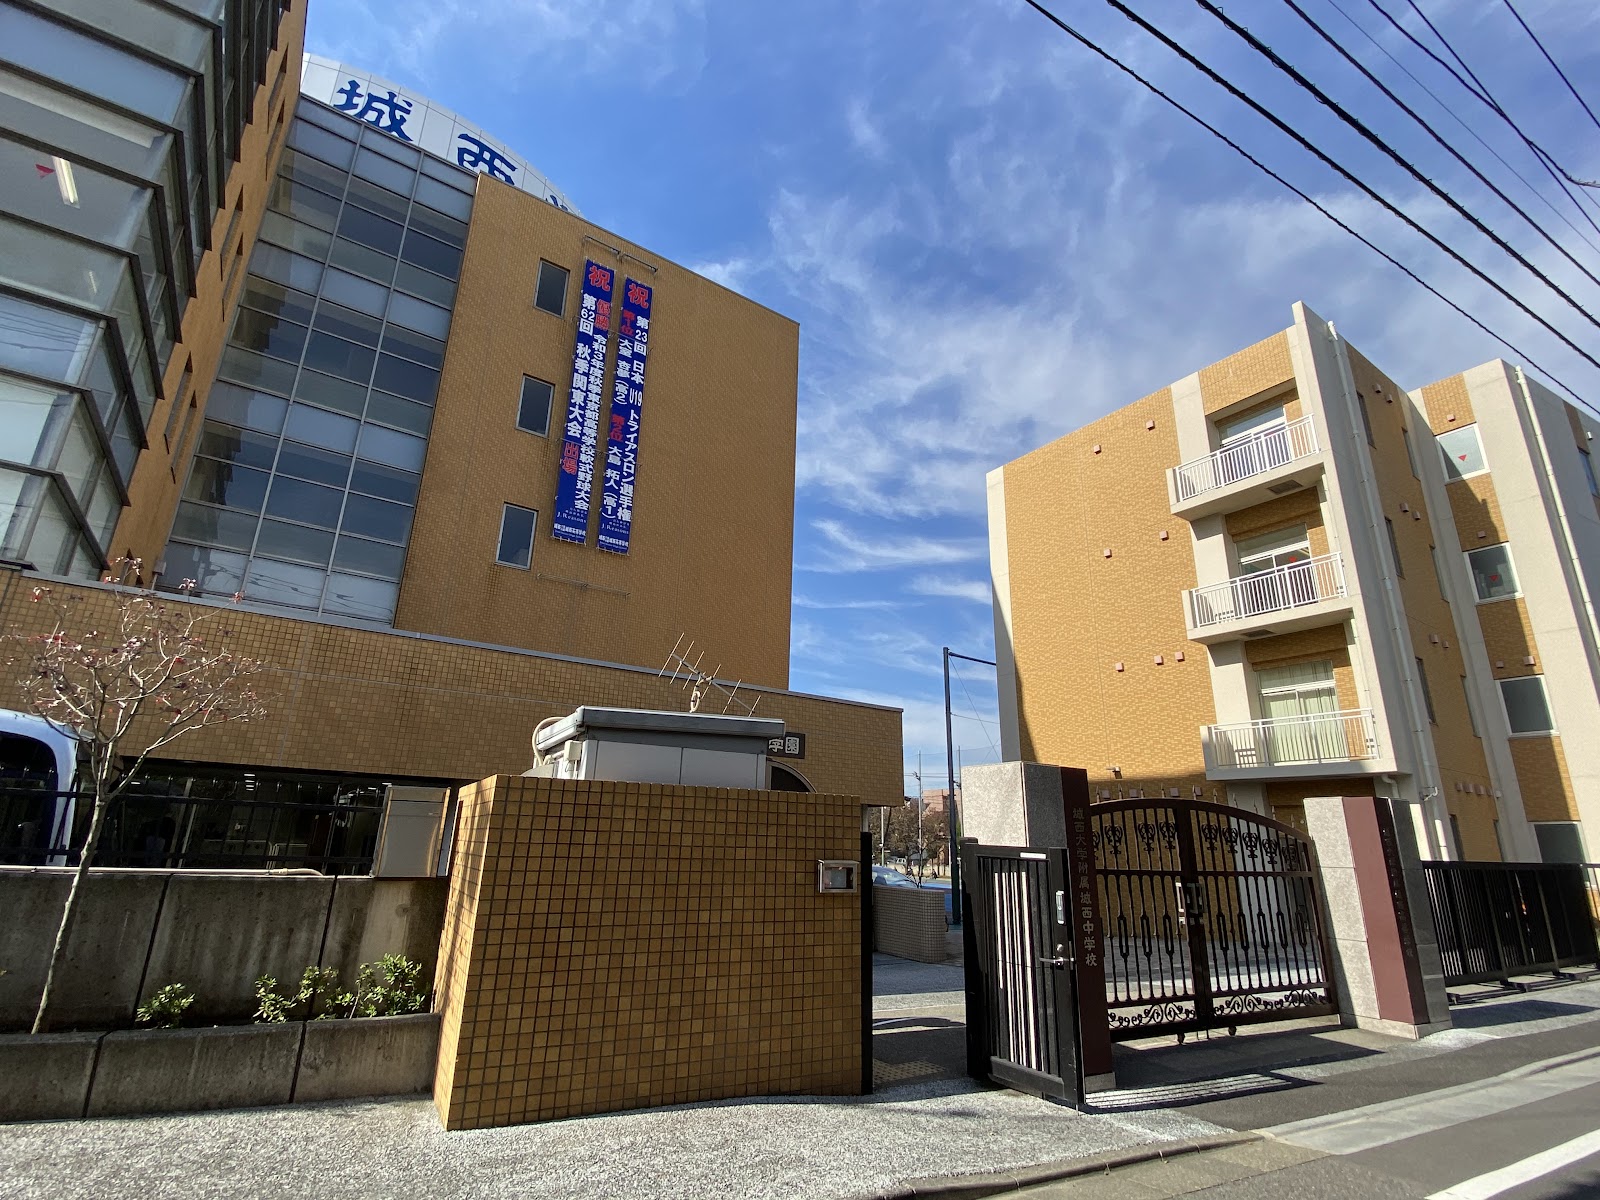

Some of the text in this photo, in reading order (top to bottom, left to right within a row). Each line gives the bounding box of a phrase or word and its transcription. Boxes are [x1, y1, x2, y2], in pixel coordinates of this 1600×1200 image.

[589, 266, 610, 291] 祝
[628, 283, 649, 308] 祝
[634, 315, 649, 356] 第23回
[562, 293, 597, 475] 第62回 秋季関東大会 出場
[631, 360, 645, 385] 日本
[629, 388, 644, 407] U19
[617, 409, 639, 522] トライアスロン選手権
[1072, 807, 1098, 967] 城西大学附属城西中学校
